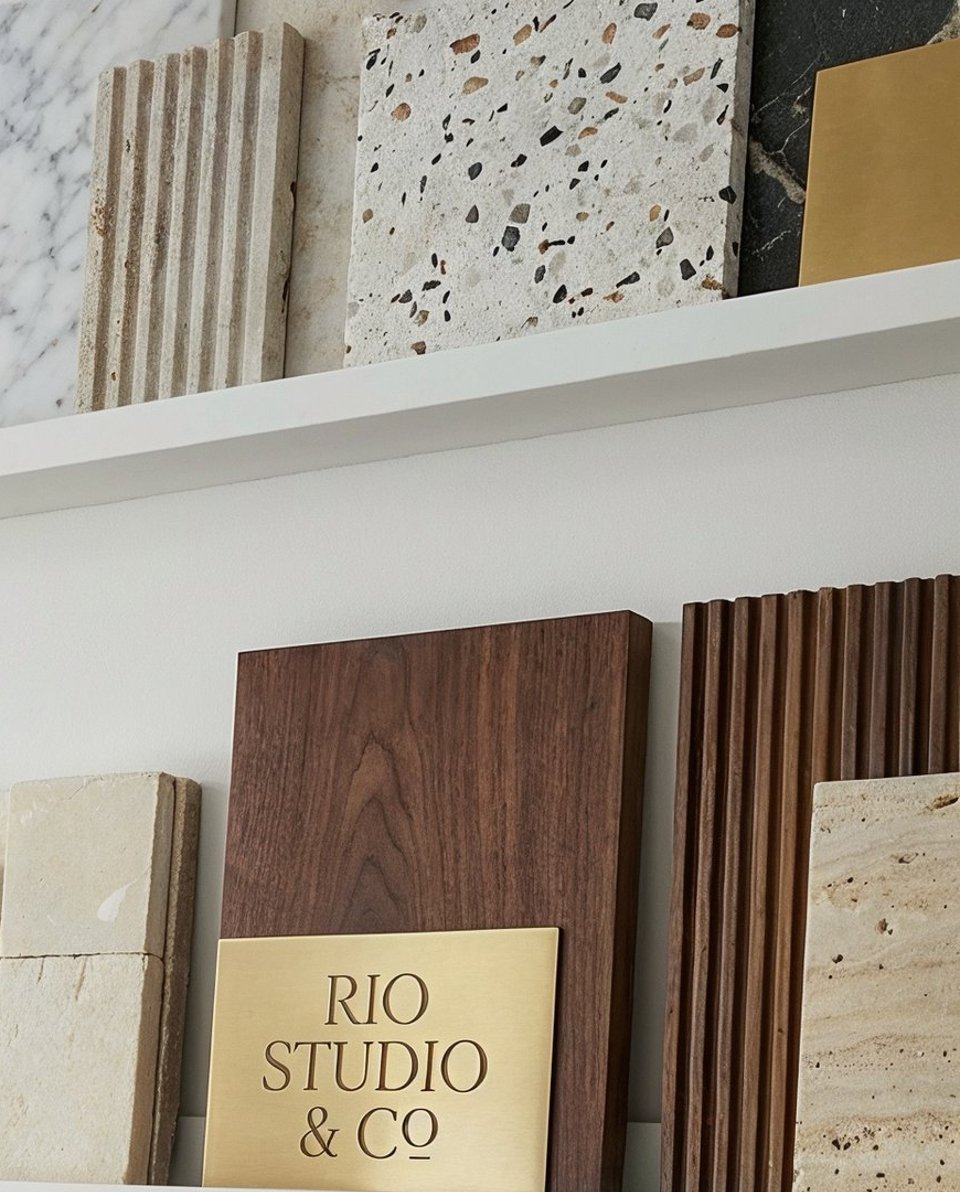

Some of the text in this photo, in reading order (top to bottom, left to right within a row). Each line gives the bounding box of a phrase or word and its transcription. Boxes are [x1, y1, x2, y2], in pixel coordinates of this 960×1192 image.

[324, 973, 430, 1026] RIO
[262, 1039, 489, 1093] STUDIO
[299, 1106, 340, 1158] &
